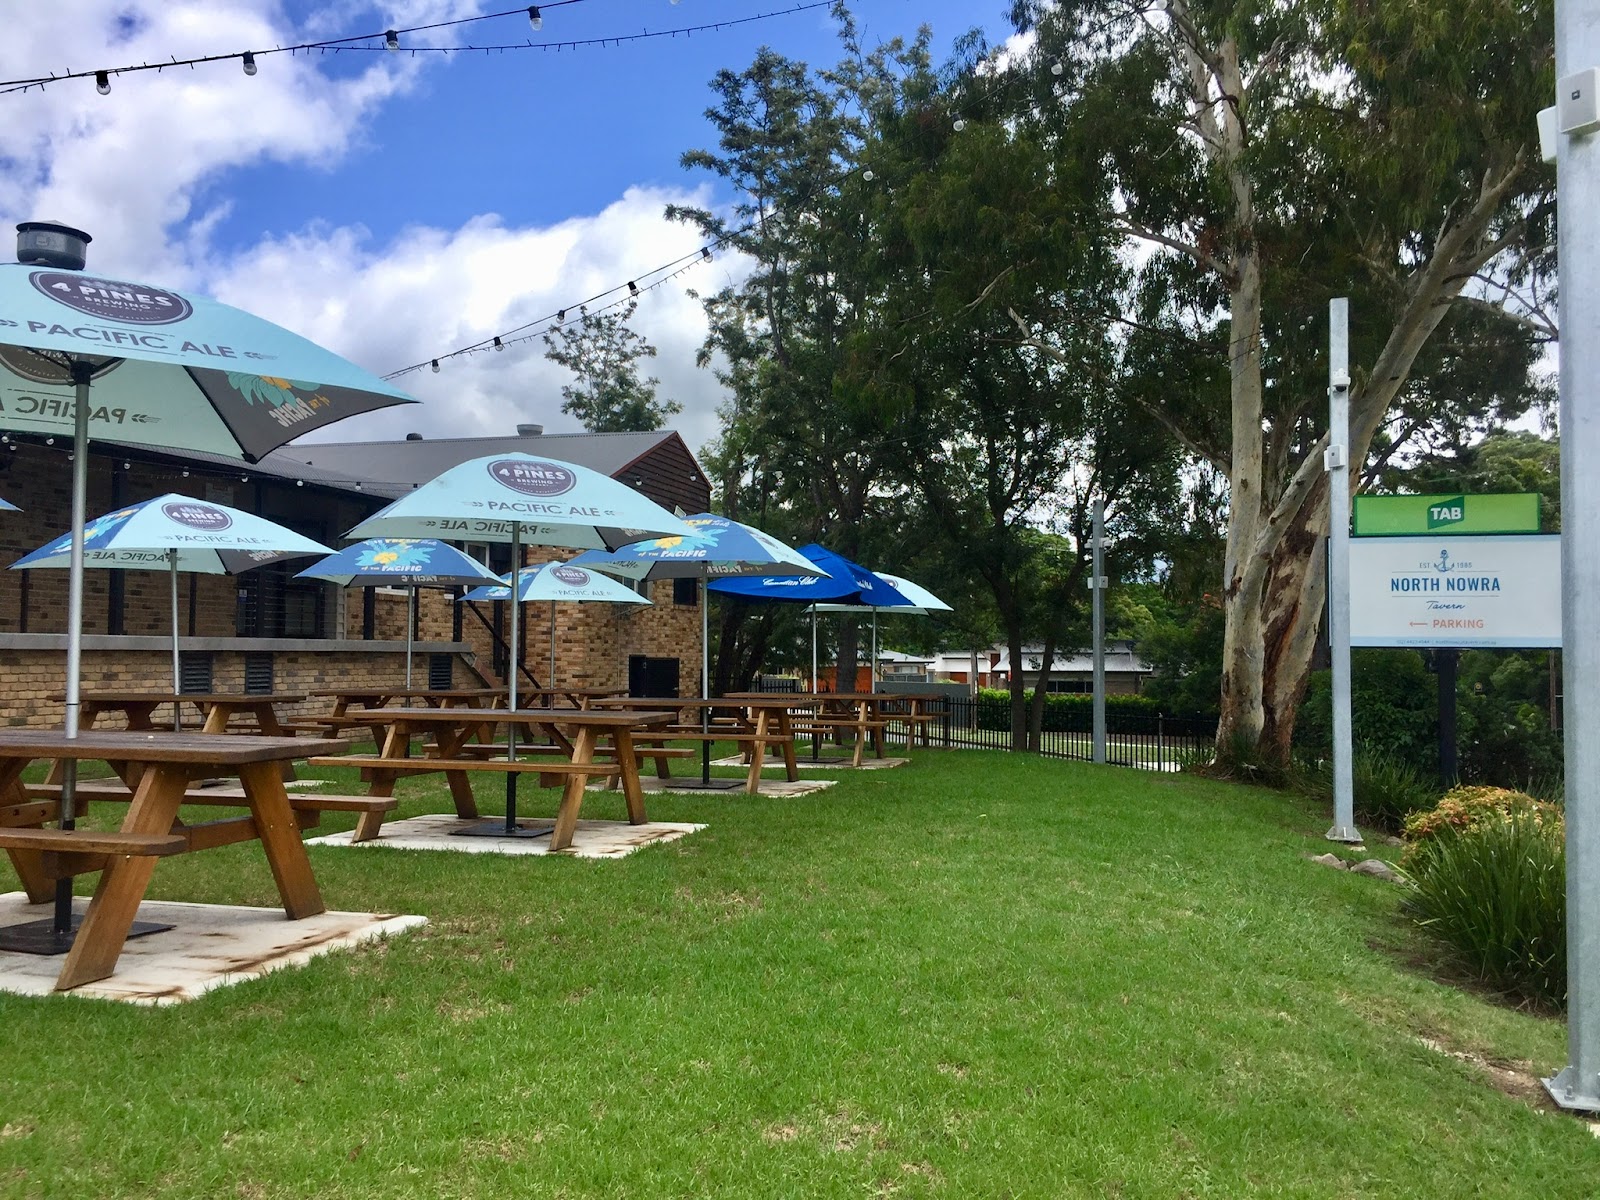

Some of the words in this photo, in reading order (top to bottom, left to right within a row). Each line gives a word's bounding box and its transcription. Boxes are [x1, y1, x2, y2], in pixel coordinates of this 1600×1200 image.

[51, 282, 72, 293] 4
[78, 285, 173, 307] PINES
[84, 295, 151, 310] BREWING
[27, 320, 169, 349] PACIFIC
[180, 340, 238, 359] ALE
[498, 468, 510, 477] 4
[513, 469, 566, 480] PINES
[488, 500, 563, 514] PACIFIC
[569, 506, 601, 517] ALE
[1430, 507, 1462, 520] TAB
[181, 512, 223, 520] PINES
[174, 535, 232, 543] PACIFIC
[660, 550, 707, 558] PACIFIC
[1391, 577, 1440, 592] NORTH
[1446, 577, 1500, 592] NOWRA
[1426, 600, 1466, 610] Tavern
[1433, 619, 1484, 629] PARKING
